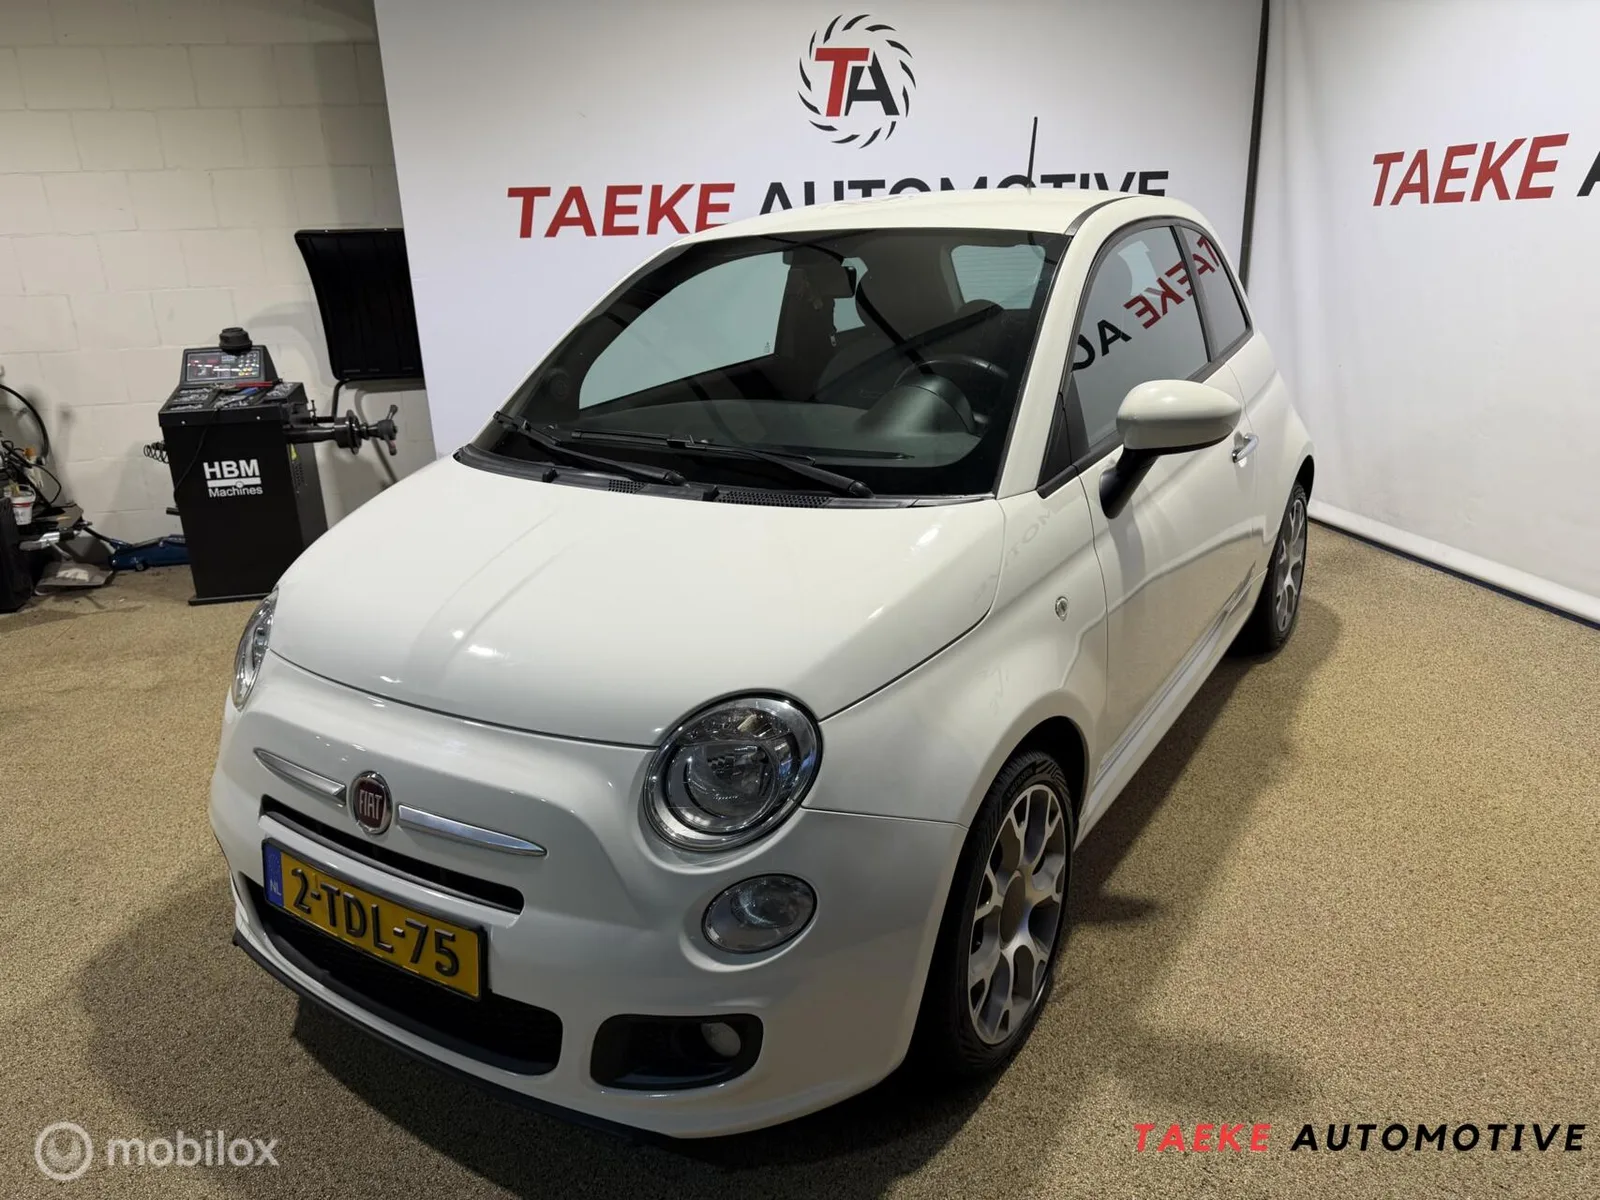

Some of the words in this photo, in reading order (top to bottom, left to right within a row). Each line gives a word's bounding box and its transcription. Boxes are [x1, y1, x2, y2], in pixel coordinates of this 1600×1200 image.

[815, 47, 900, 117] TA
[1373, 133, 1569, 207] TAEKE
[507, 182, 736, 239] TAEKE
[203, 459, 260, 479] HBM
[208, 486, 263, 498] Machines
[360, 789, 383, 820] FIAT
[269, 879, 282, 896] NL
[291, 867, 460, 978] 2-TDL-75
